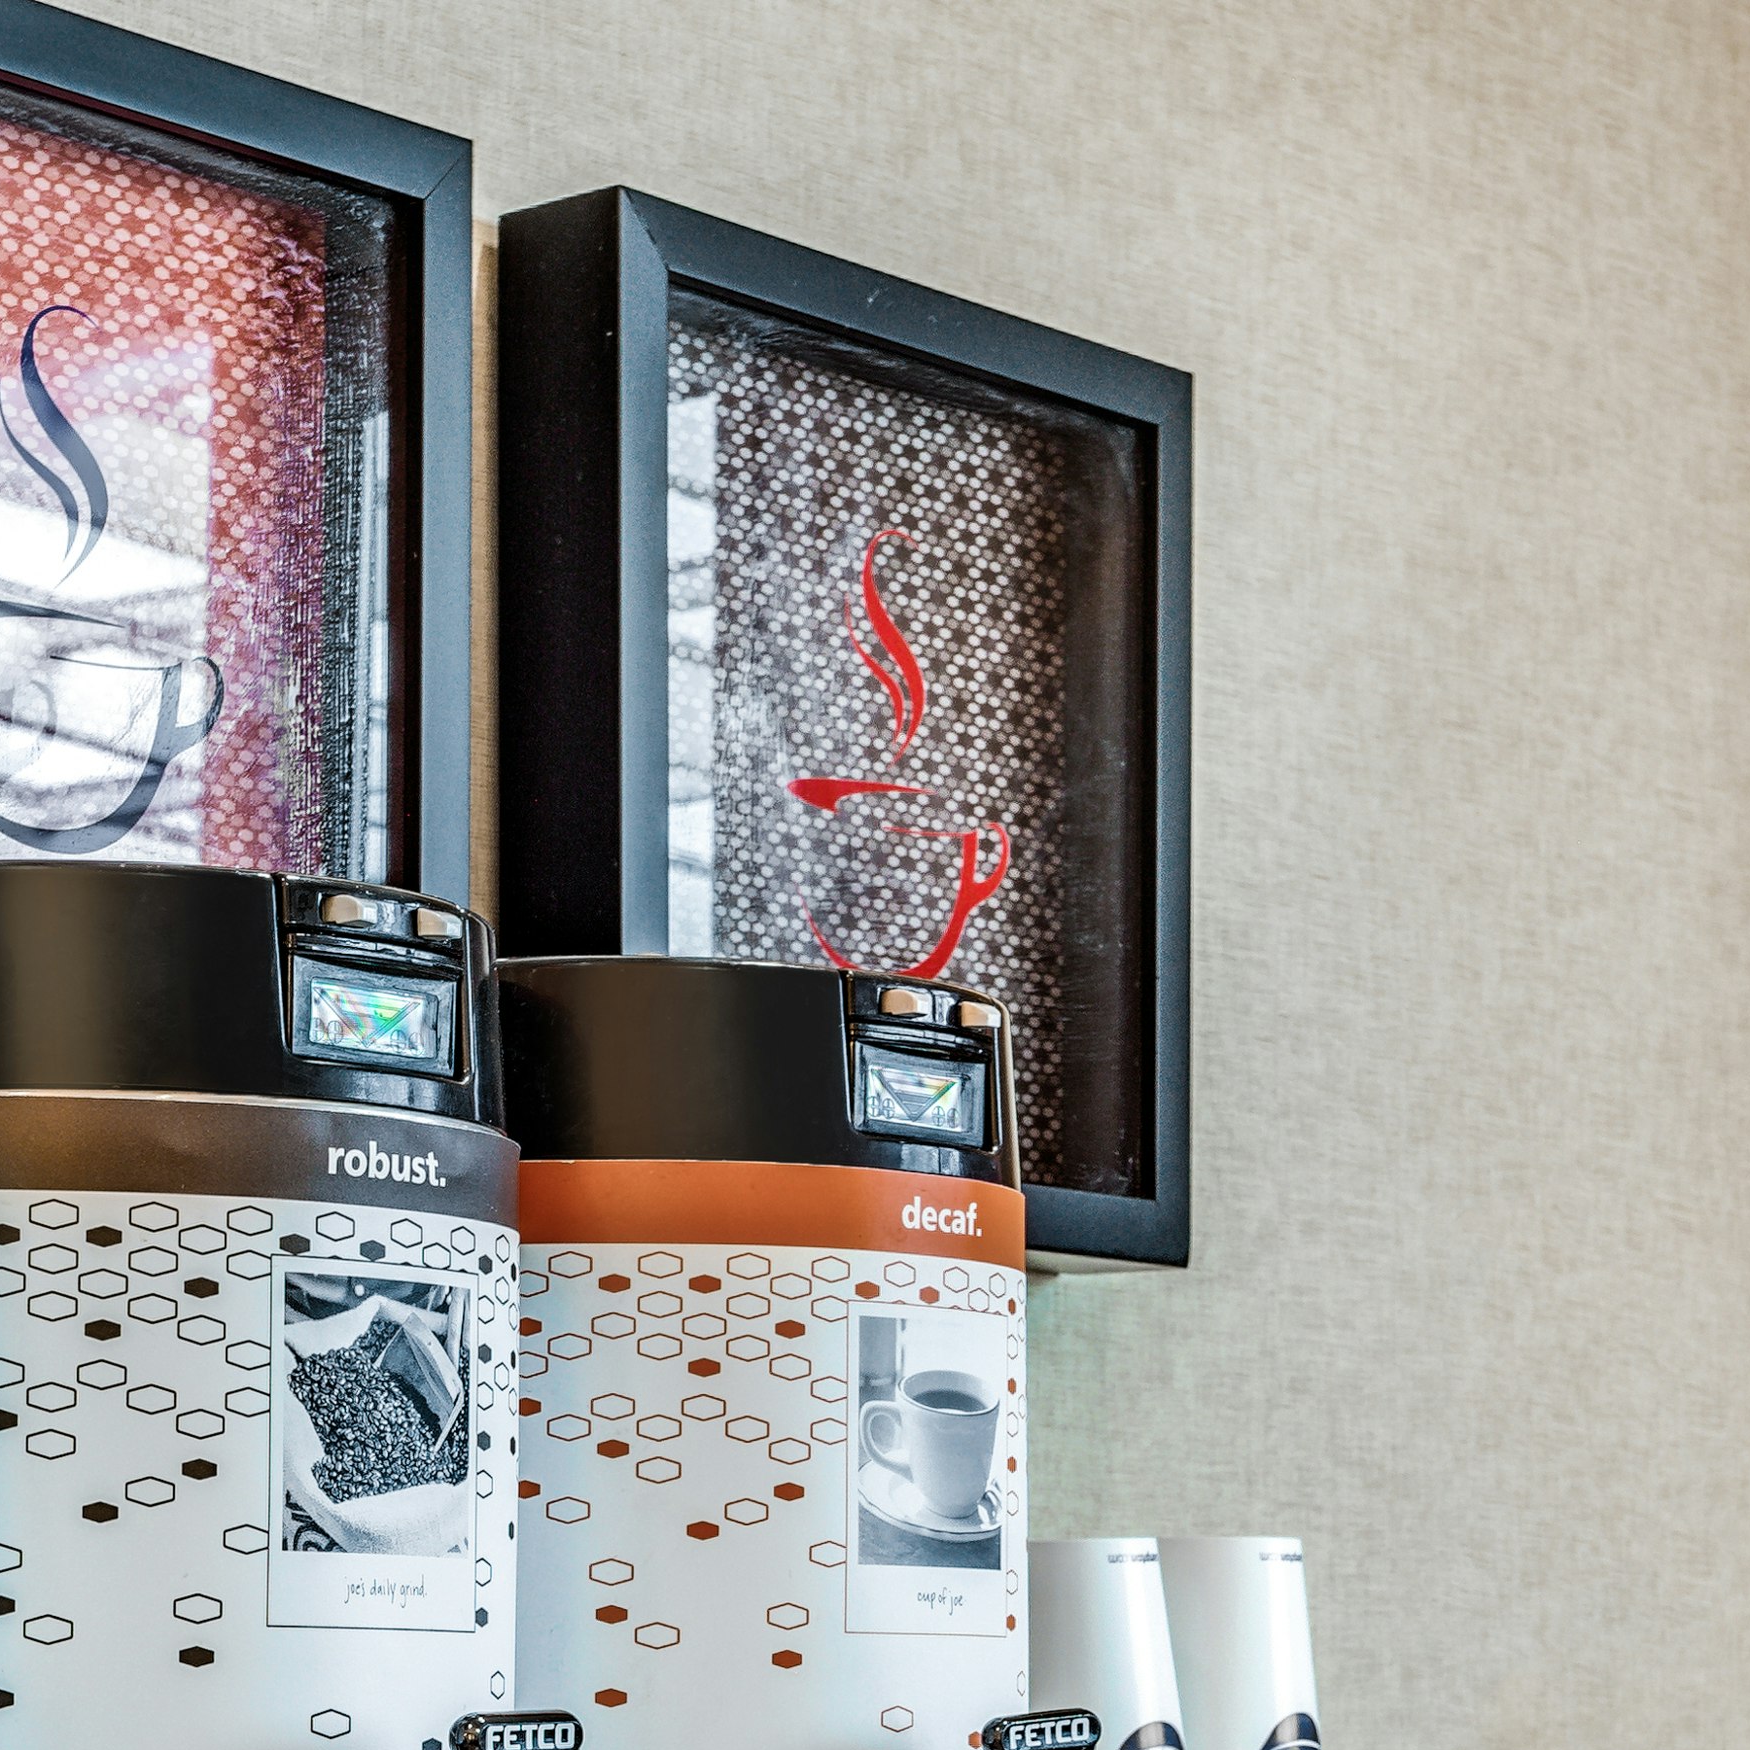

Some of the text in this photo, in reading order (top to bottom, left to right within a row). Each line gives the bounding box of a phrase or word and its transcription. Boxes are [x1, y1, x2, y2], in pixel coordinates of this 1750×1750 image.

[328, 1140, 446, 1187] robust.
[902, 1196, 982, 1237] decaf.
[369, 1578, 397, 1604] daily
[400, 1573, 427, 1609] grind.
[917, 1592, 936, 1610] cup
[938, 1586, 948, 1605] of
[1009, 1717, 1090, 1750] FETCO
